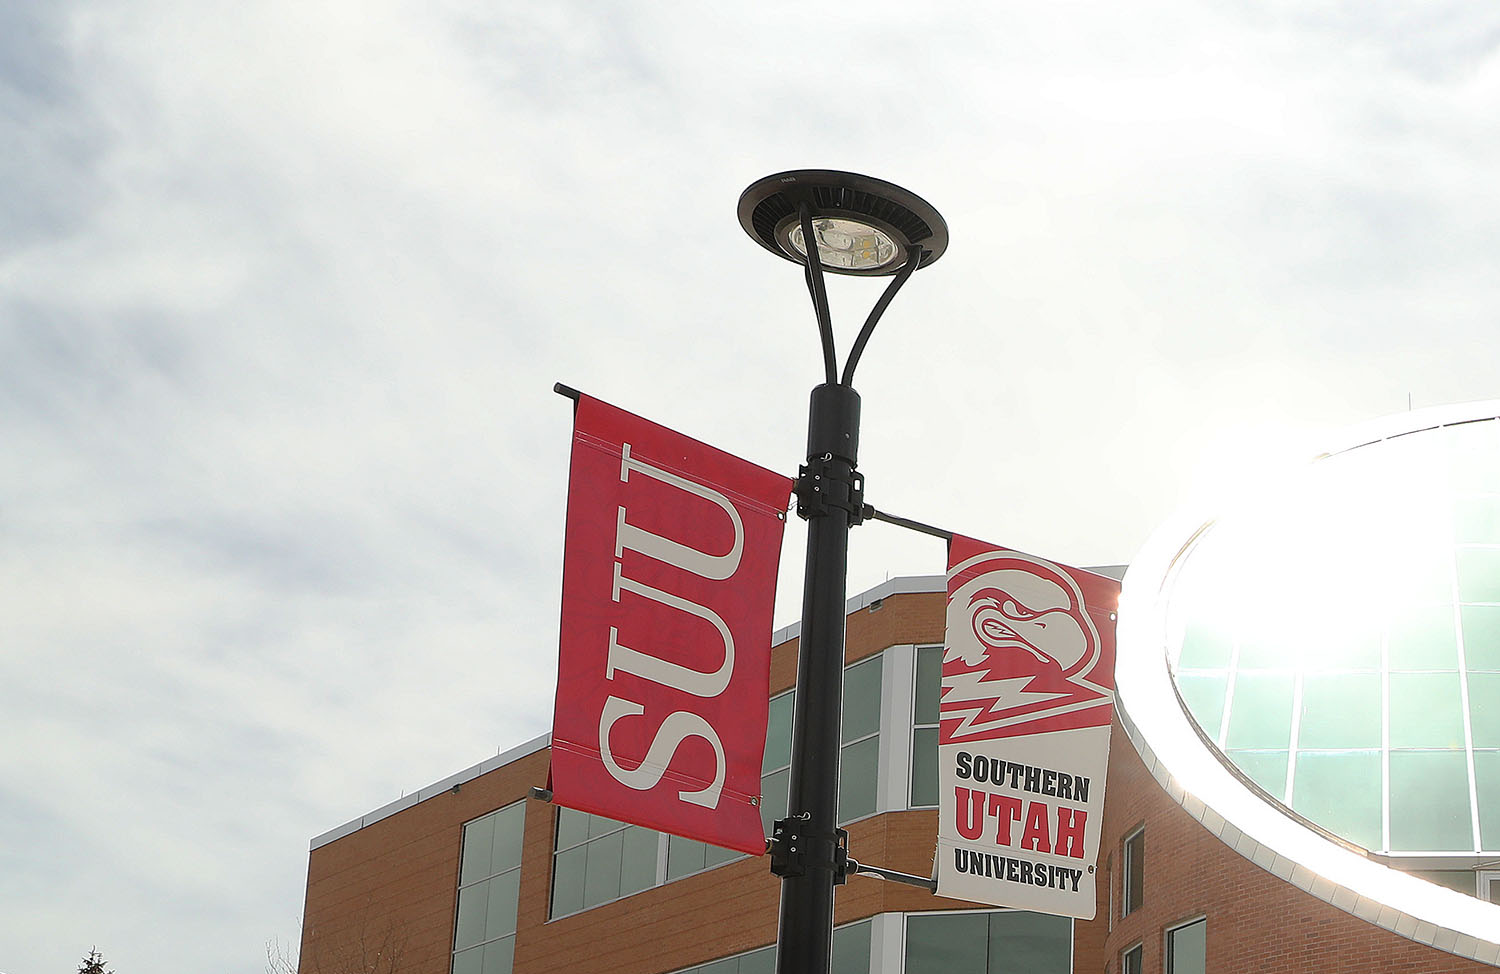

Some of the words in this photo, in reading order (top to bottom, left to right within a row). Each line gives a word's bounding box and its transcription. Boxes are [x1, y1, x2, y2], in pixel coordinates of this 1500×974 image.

[599, 442, 745, 809] SUU
[955, 751, 1091, 803] SOUTHERN
[954, 786, 1088, 860] UTAH
[954, 848, 1083, 893] UNIVERSITY
